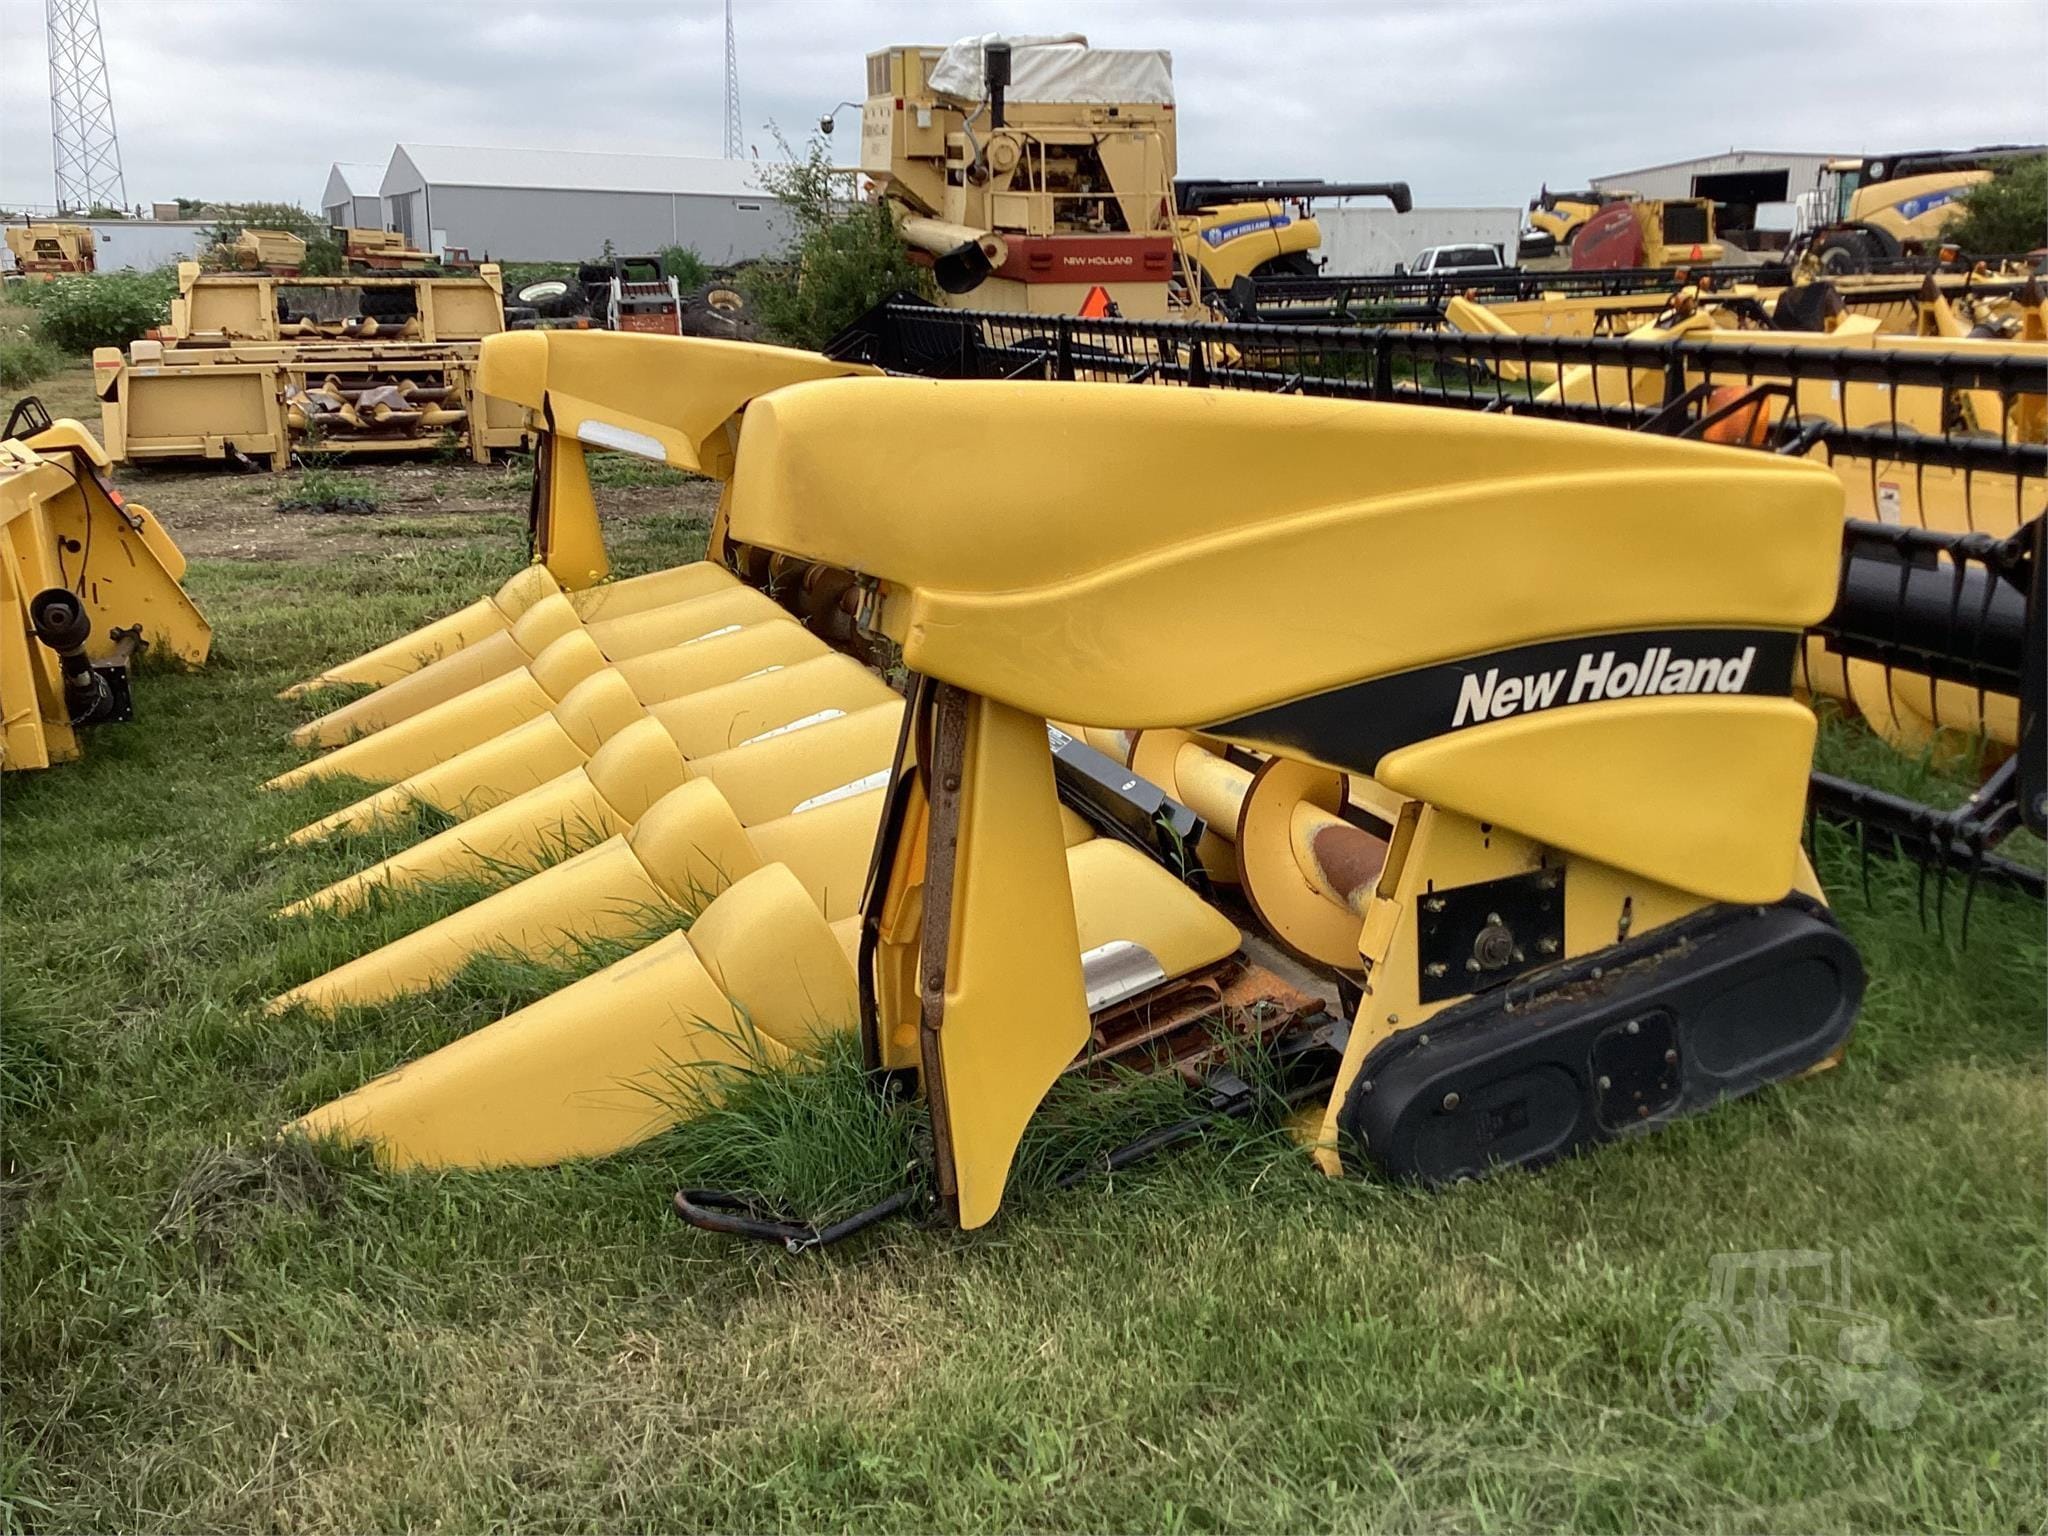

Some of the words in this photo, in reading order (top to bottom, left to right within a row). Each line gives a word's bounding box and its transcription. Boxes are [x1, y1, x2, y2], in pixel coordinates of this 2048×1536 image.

[1063, 256, 1086, 265] NEW
[1087, 256, 1133, 266] HOLLAND
[1451, 668, 1567, 727] New
[1567, 646, 1757, 703] Holland
